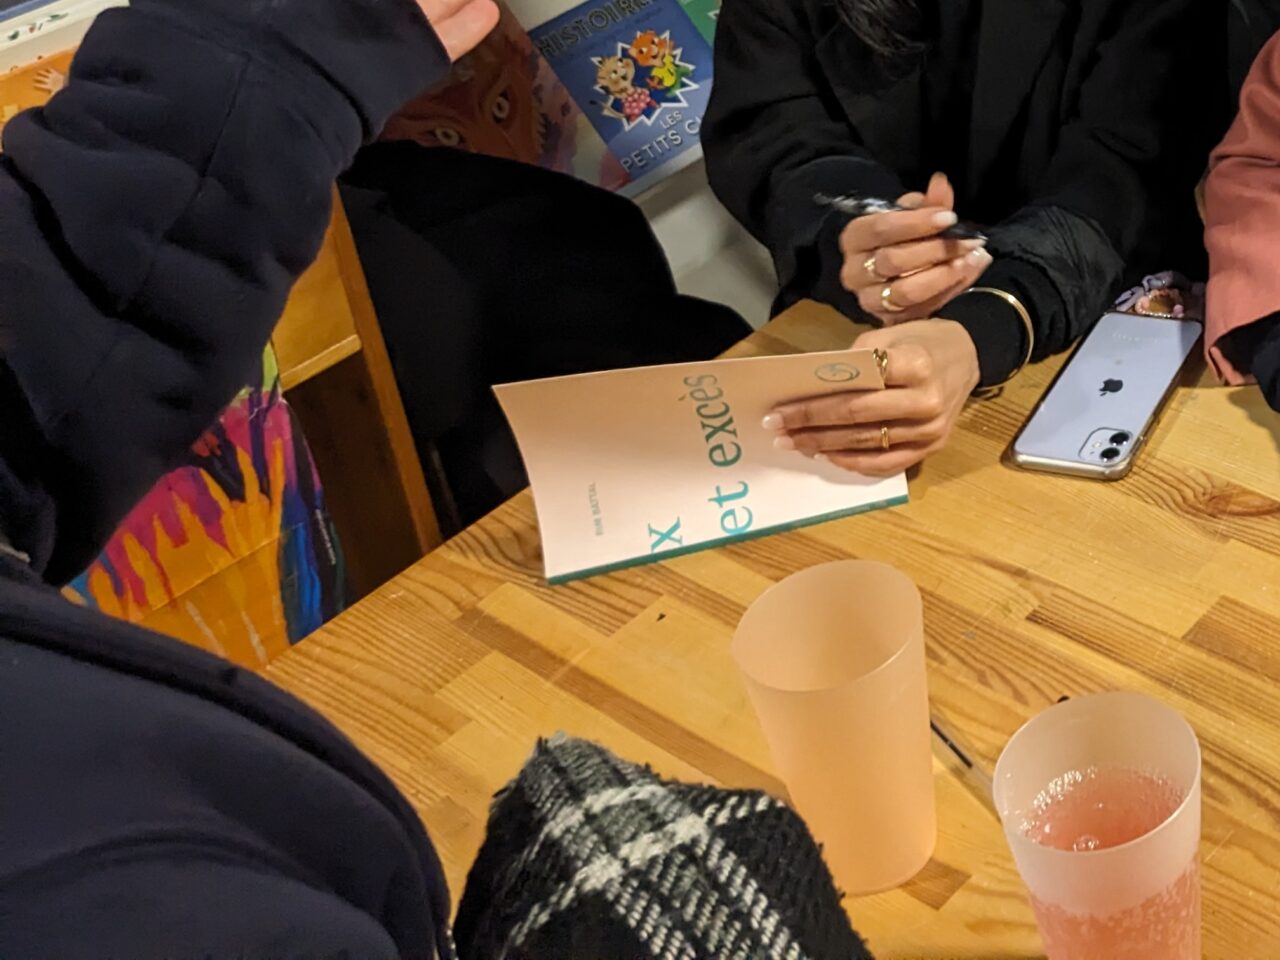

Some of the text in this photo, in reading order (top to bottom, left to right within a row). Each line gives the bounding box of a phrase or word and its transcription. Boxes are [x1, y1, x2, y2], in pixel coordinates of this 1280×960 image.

[660, 111, 682, 129] LES
[621, 130, 682, 173] PETITS
[678, 373, 754, 537] et excès
